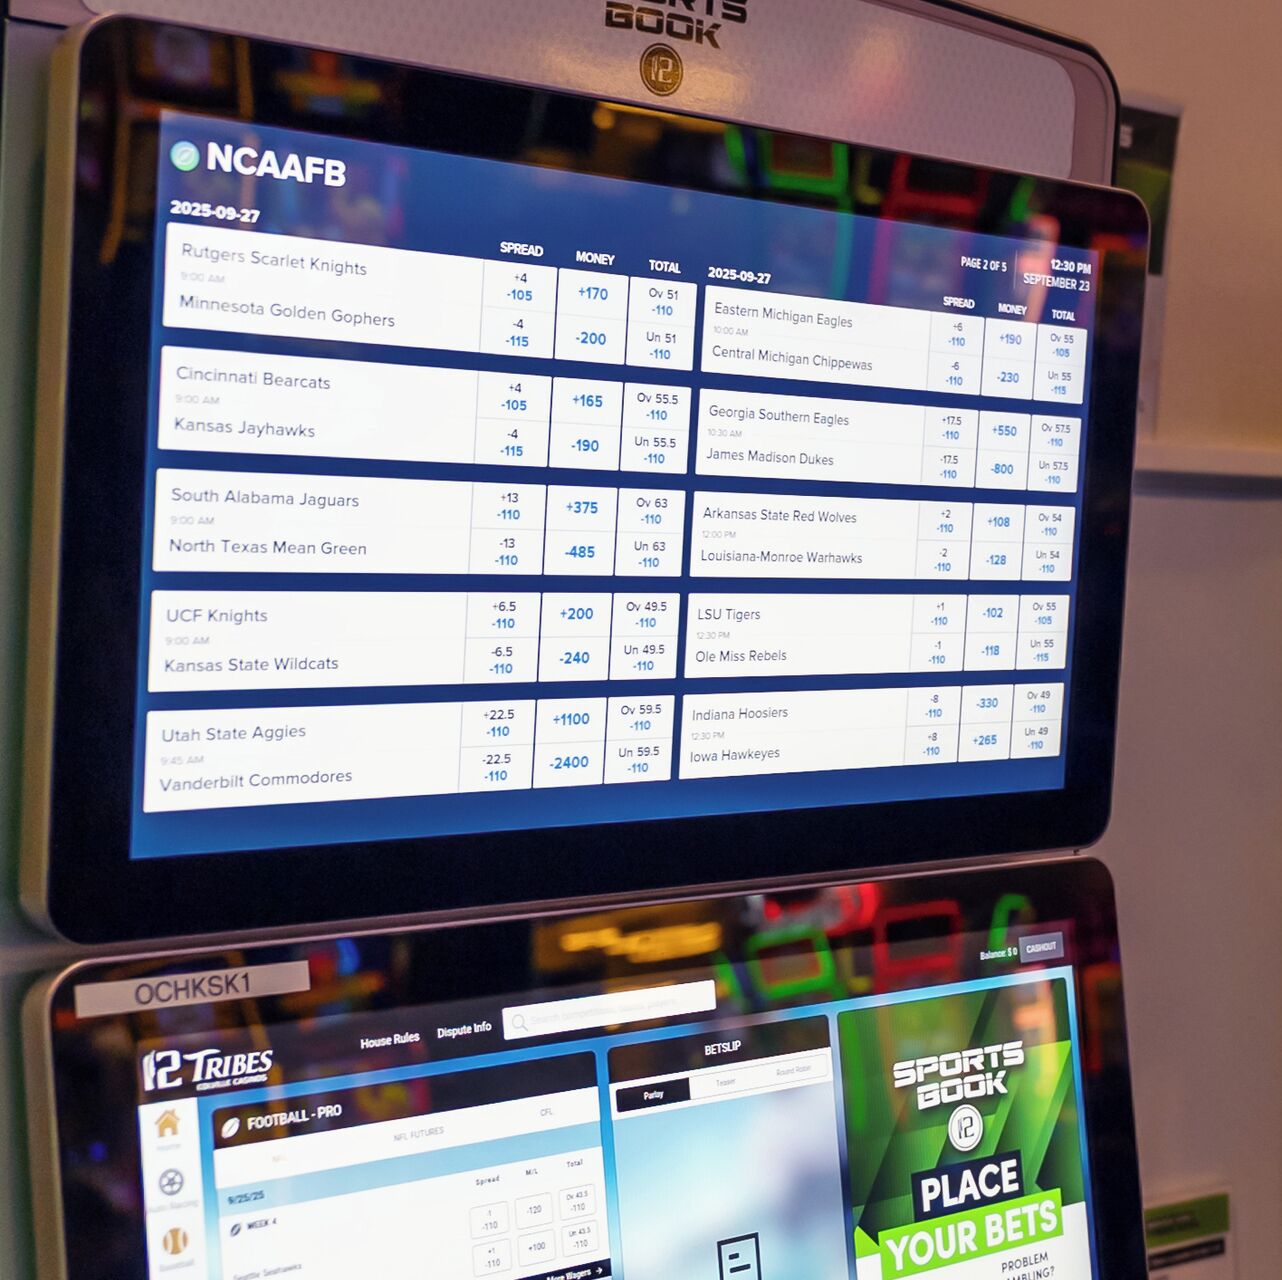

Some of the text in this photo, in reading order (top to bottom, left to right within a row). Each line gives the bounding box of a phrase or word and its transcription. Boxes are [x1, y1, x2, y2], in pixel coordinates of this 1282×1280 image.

[605, 1, 722, 49] BOOK
[207, 143, 346, 188] NCAAFB
[171, 201, 260, 223] 2025-09-27
[182, 244, 367, 277] Rutgers Scarlet Knights
[500, 242, 681, 274] SPREAD MONEY TOTAL
[961, 256, 1007, 272] PAGE 2 OF 5
[1051, 259, 1091, 275] 12:30 PM
[708, 267, 771, 285] 2025-09-27
[1023, 272, 1090, 291] SEPTEMBER 23
[579, 287, 608, 301] +170
[180, 295, 395, 330] Minnesota Golden Gophers
[715, 302, 853, 329] Eastern Michigan Eagles
[943, 296, 1075, 322] SPREAD MONEY TOTAL
[576, 332, 606, 346] -200
[1000, 333, 1022, 345] +190
[713, 345, 872, 372] Central Michigan Chippewas
[177, 367, 330, 390] Cincinnati Bearcats
[997, 372, 1019, 383] -230
[573, 394, 602, 408] +165
[710, 405, 849, 427] Georgia Southern Eagles
[175, 418, 315, 439] Kansas Jayhawks
[992, 425, 1017, 437] +550
[571, 439, 599, 453] -190
[707, 448, 834, 466] James Madison Dukes
[991, 463, 1014, 475] -800
[172, 488, 359, 511] South Alabama Jaguars
[567, 500, 598, 514] +375
[703, 507, 857, 524] Arkansas State Red Wolves
[170, 539, 367, 556] North Texas Mean Green
[565, 545, 595, 559] -485
[701, 550, 862, 564] Louisiana-Monroe Warhawks
[167, 608, 268, 626] UCF Knights
[560, 607, 593, 620] +200
[698, 608, 760, 623] LSU Tigers
[165, 655, 339, 674] Kansas State Wildcats
[560, 651, 590, 664] -240
[696, 649, 786, 662] Ole Miss Rebels
[553, 712, 590, 727] +1100
[692, 707, 788, 721] Indiana Hoosiers
[162, 724, 306, 744] Utah State Aggies
[550, 755, 589, 770] -2400
[690, 747, 780, 763] Iowa Hawkeyes
[160, 769, 352, 793] Vanderbilt Commodores
[981, 949, 1005, 961] Balance:
[1026, 941, 1056, 953] CASHOUT
[135, 975, 251, 1005] OCHKSK1
[437, 1021, 492, 1041] Dispute Info
[360, 1031, 420, 1050] House Rules
[705, 1040, 741, 1056] BETSLIP
[184, 1048, 273, 1084] TRIBES
[893, 1041, 1024, 1088] SPORTS
[644, 1089, 664, 1101] Parlay
[917, 1070, 1008, 1111] BOOK
[247, 1108, 308, 1131] FOOTBALL
[317, 1104, 342, 1119] PRO
[920, 1159, 1019, 1213] PLACE
[885, 1200, 1058, 1271] YOUR BETS
[1001, 1252, 1049, 1273] PROBLEM
